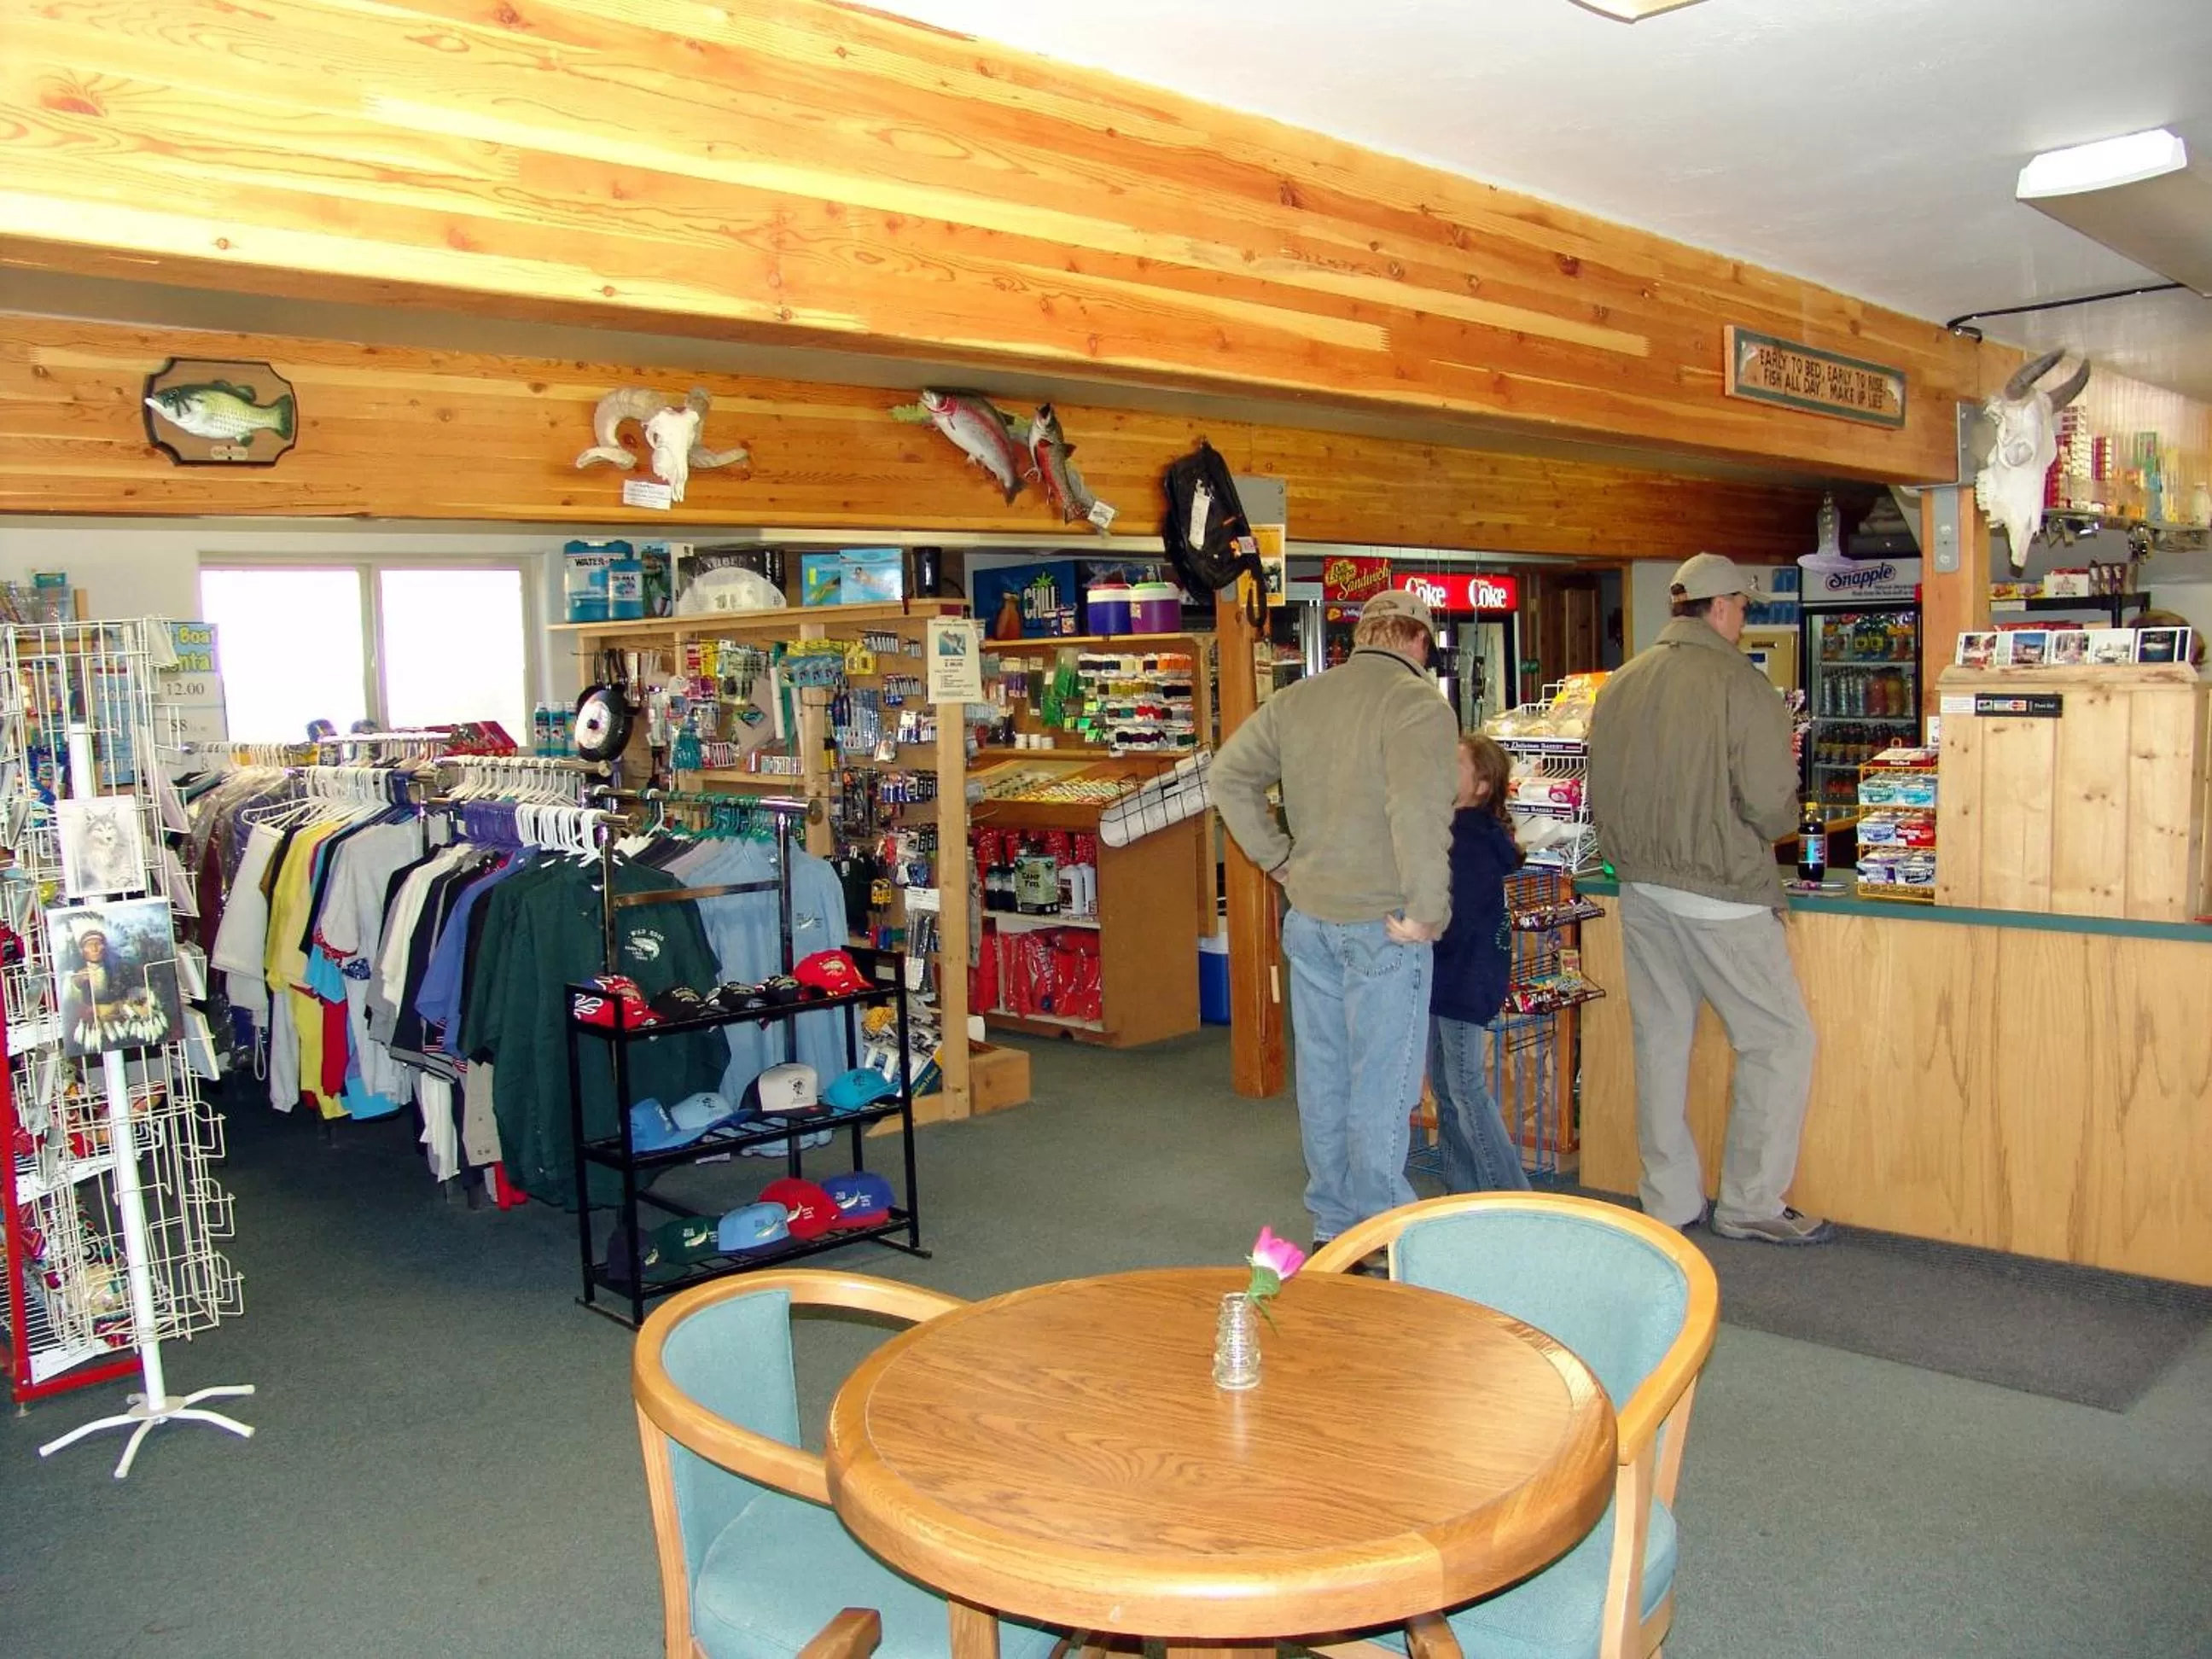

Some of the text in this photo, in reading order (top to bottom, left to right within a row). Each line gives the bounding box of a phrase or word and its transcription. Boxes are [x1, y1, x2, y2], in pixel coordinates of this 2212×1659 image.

[1760, 349, 1787, 370] EARLY
[1791, 356, 1802, 375] TO
[1827, 364, 1852, 386] EARLY
[1785, 373, 1801, 393] ALL
[1830, 383, 1854, 405] MAKE
[1336, 558, 1389, 601] Sandwich
[1829, 562, 1893, 589] Snapple
[1024, 585, 1057, 620] CHILL
[1405, 578, 1508, 608] Coke Coke
[166, 682, 205, 696] 12.00
